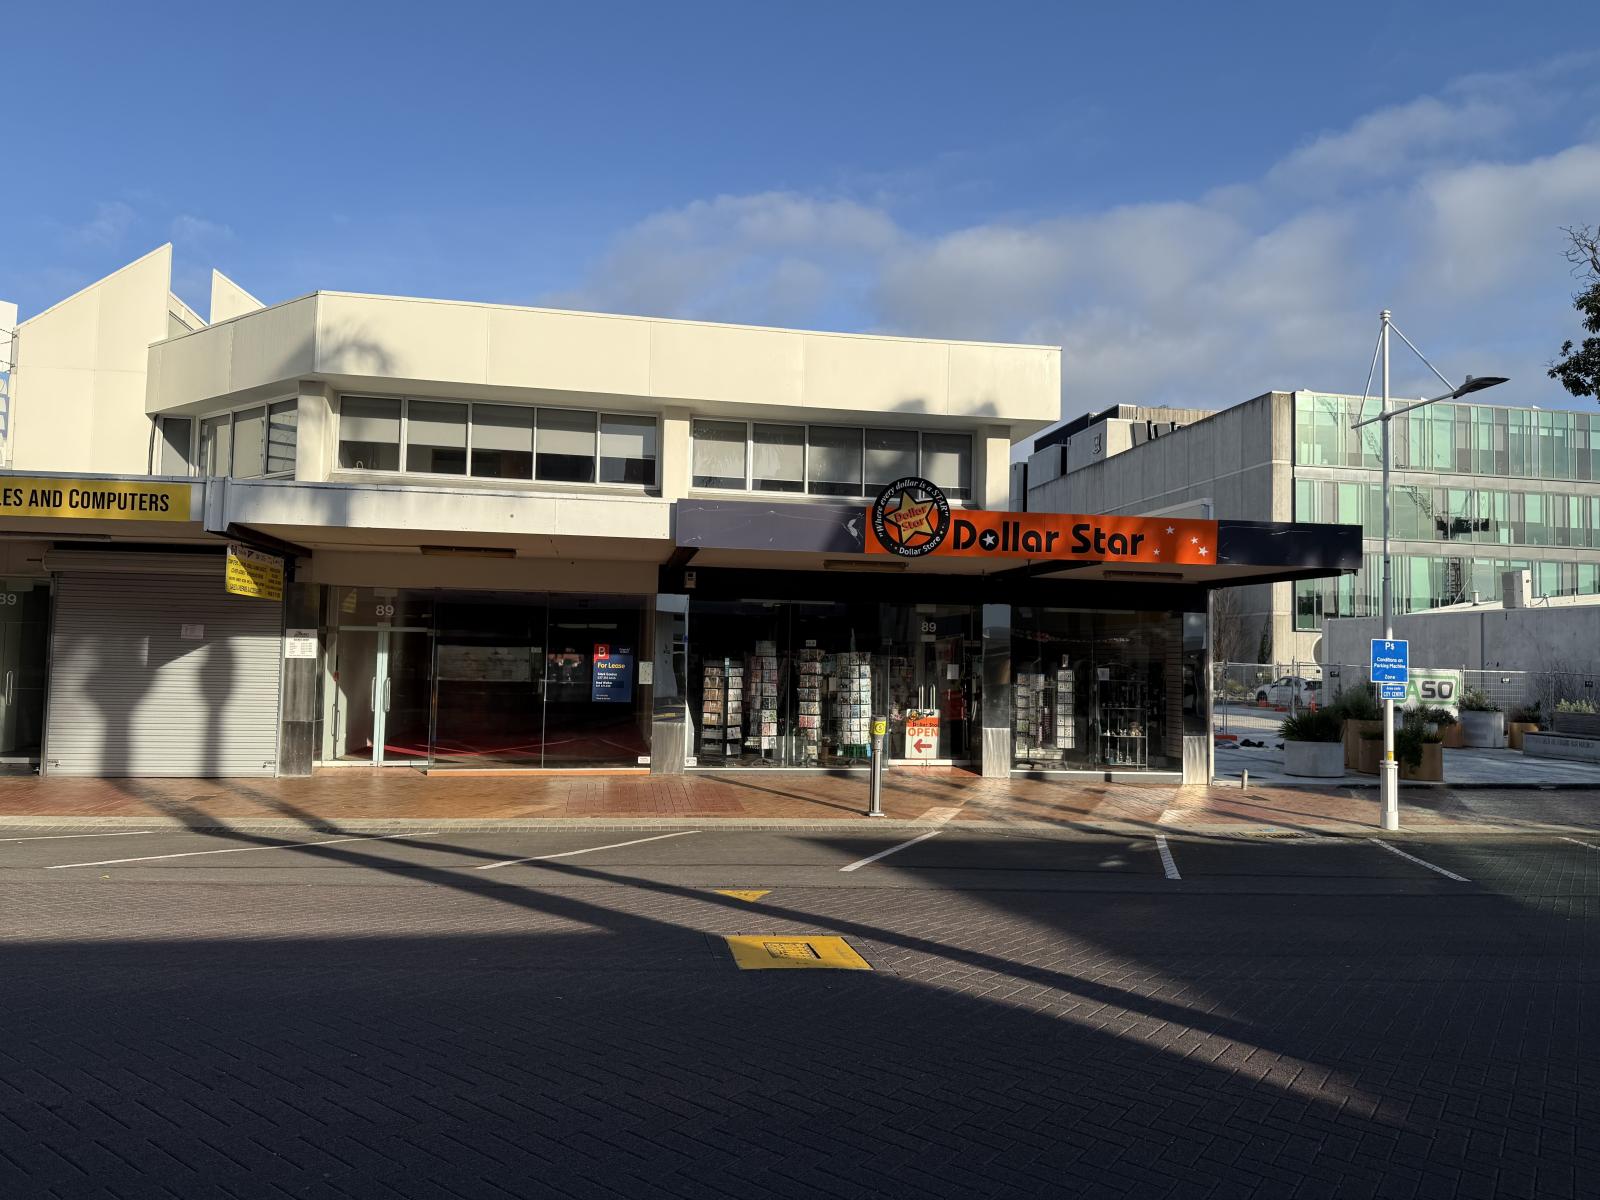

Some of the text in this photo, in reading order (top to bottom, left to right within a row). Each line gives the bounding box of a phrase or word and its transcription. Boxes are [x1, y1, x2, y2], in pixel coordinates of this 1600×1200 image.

[0, 488, 23, 507] ES
[28, 489, 63, 508] AND
[881, 487, 894, 505] every
[896, 480, 918, 490] dollar
[920, 481, 926, 489] is
[899, 536, 941, 556] Dollar Store
[952, 519, 1144, 556] Dollar Star
[375, 605, 394, 616] 89
[921, 622, 936, 632] 89
[907, 727, 940, 737] OPEN
